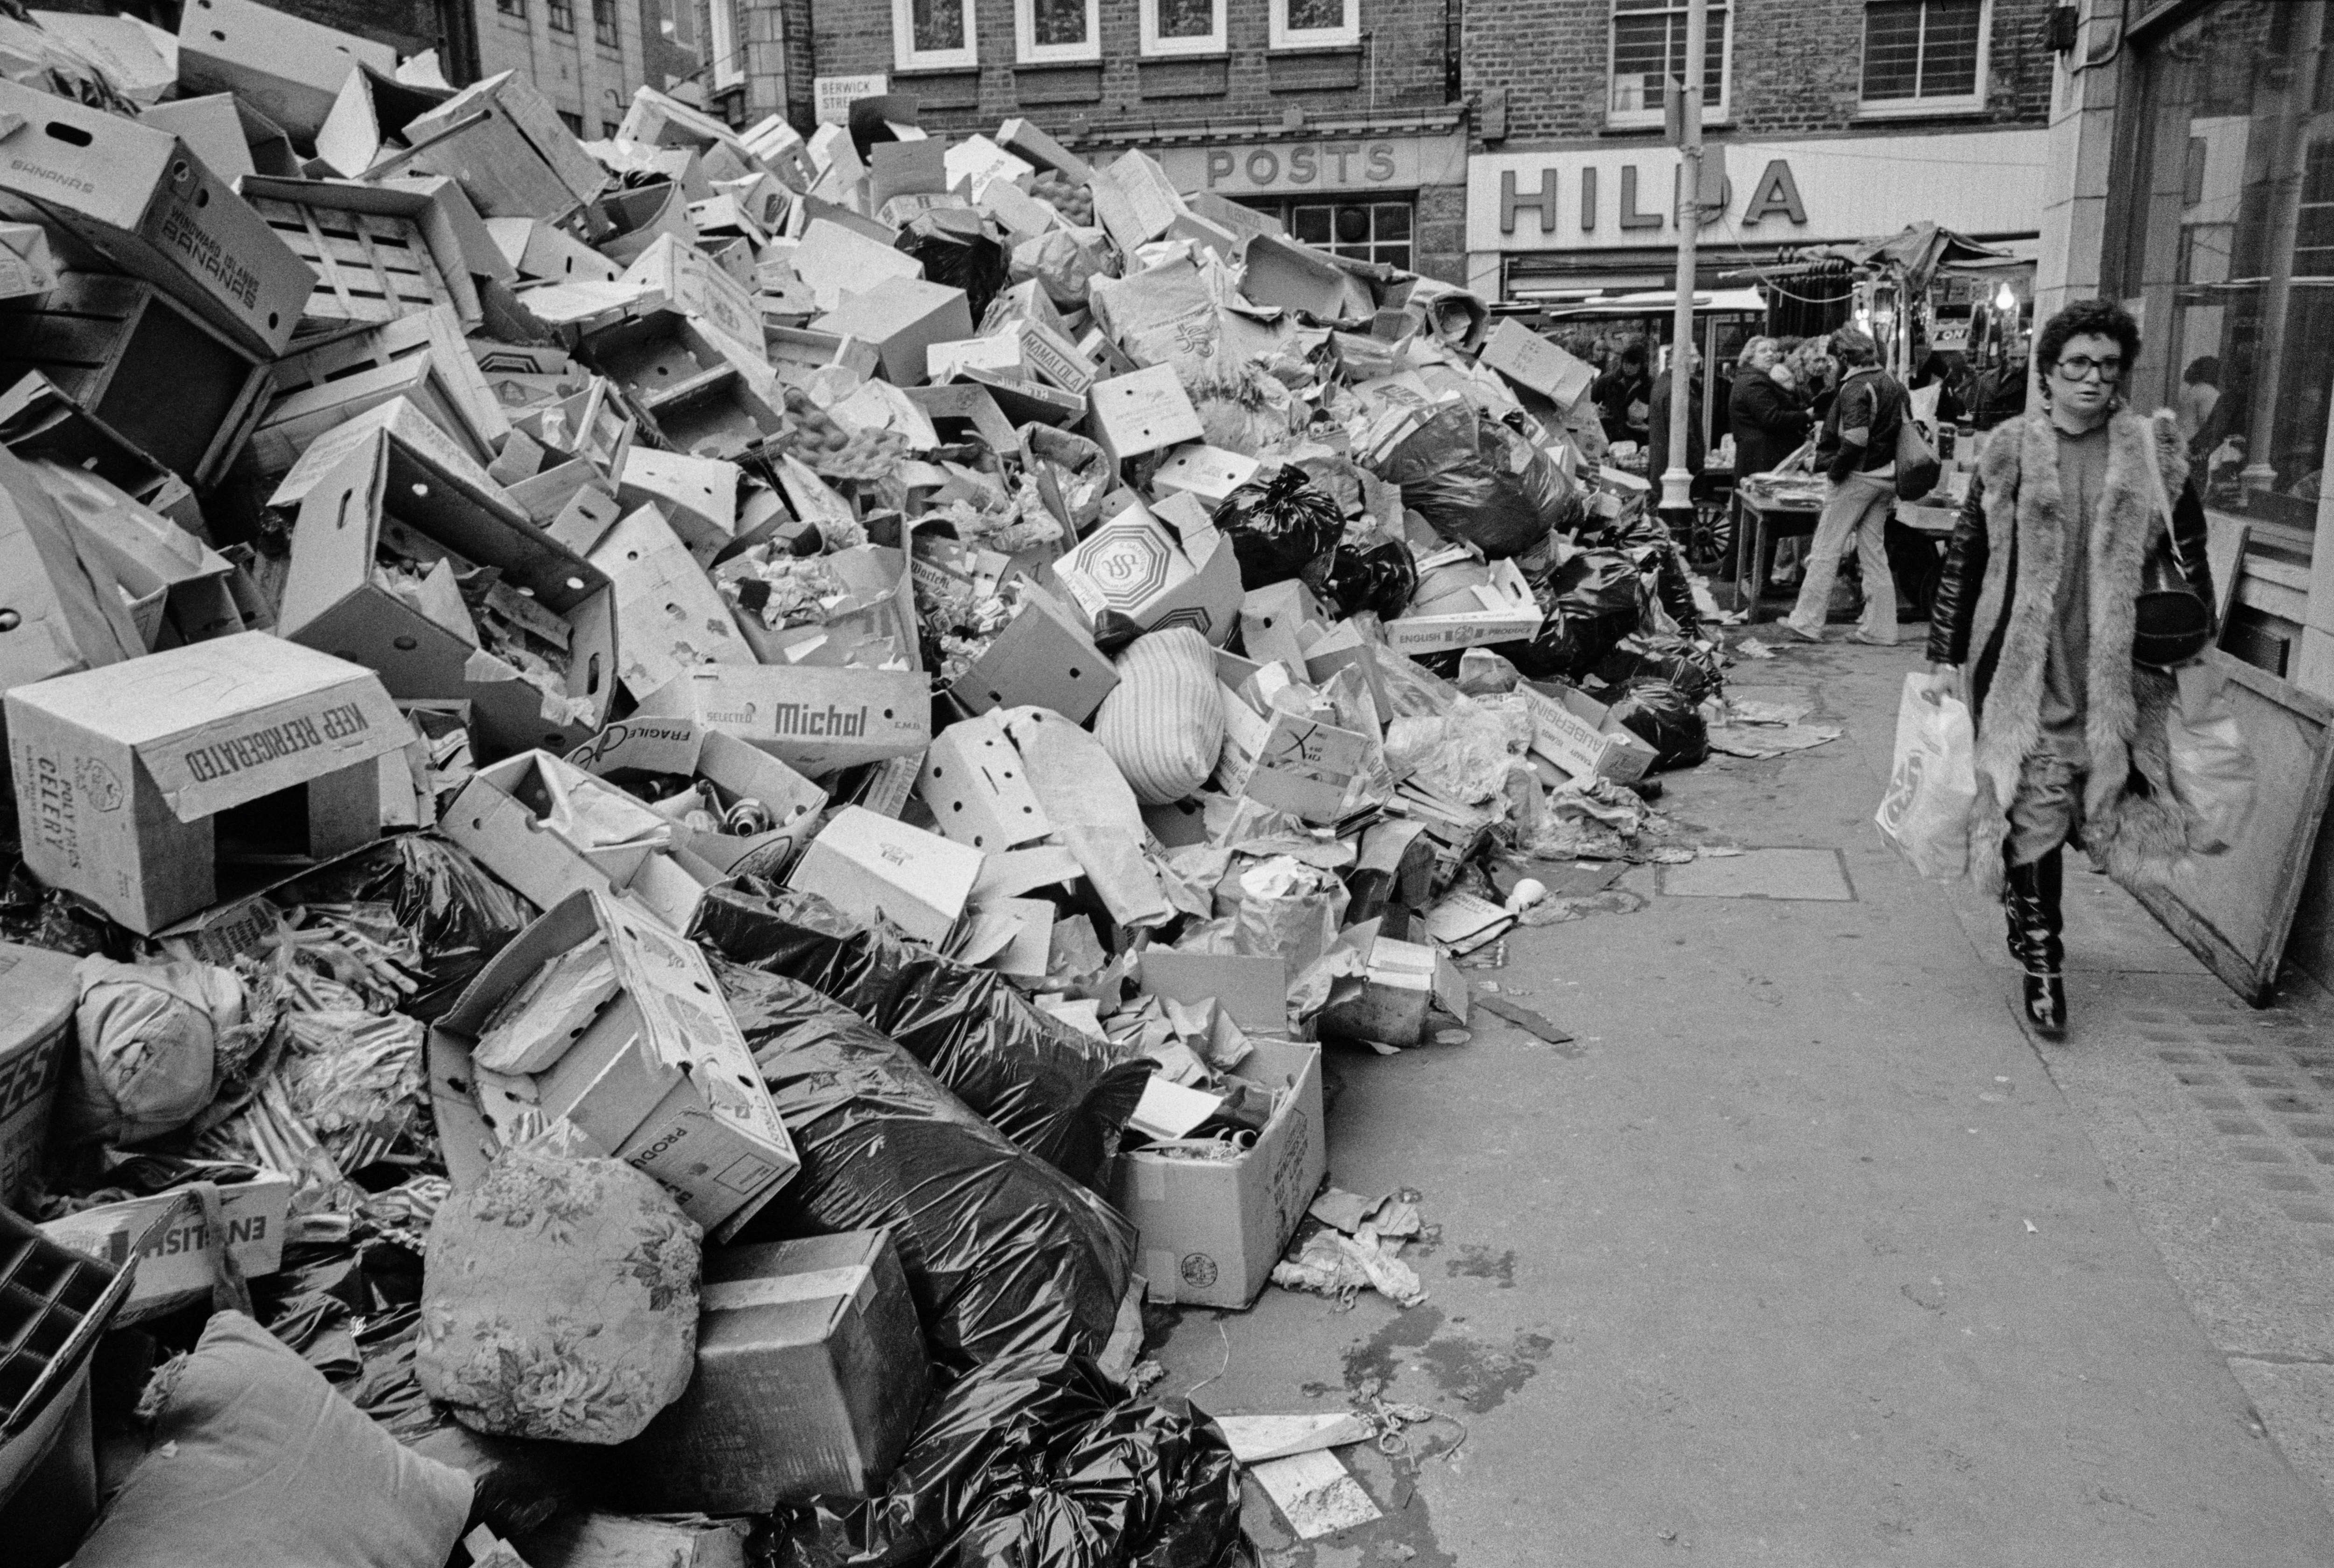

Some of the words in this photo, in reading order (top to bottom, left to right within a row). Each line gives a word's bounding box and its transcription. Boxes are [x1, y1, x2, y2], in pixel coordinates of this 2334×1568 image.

[821, 81, 871, 95] BERWICK
[11, 160, 96, 195] BANANAS
[1207, 143, 1396, 188] POSTS
[170, 205, 222, 256] WINDWARD
[161, 223, 258, 310] BANANAS
[1399, 633, 1441, 644] ENGLISH
[323, 703, 369, 741] KEEP
[627, 726, 690, 742] FRAGILE
[707, 712, 752, 723] SELECTED
[774, 702, 867, 737] Michal
[185, 717, 322, 783] REFRIGERATED
[38, 757, 63, 853] CELERY
[60, 779, 74, 823] POLY
[145, 1216, 265, 1258] ENLISH
